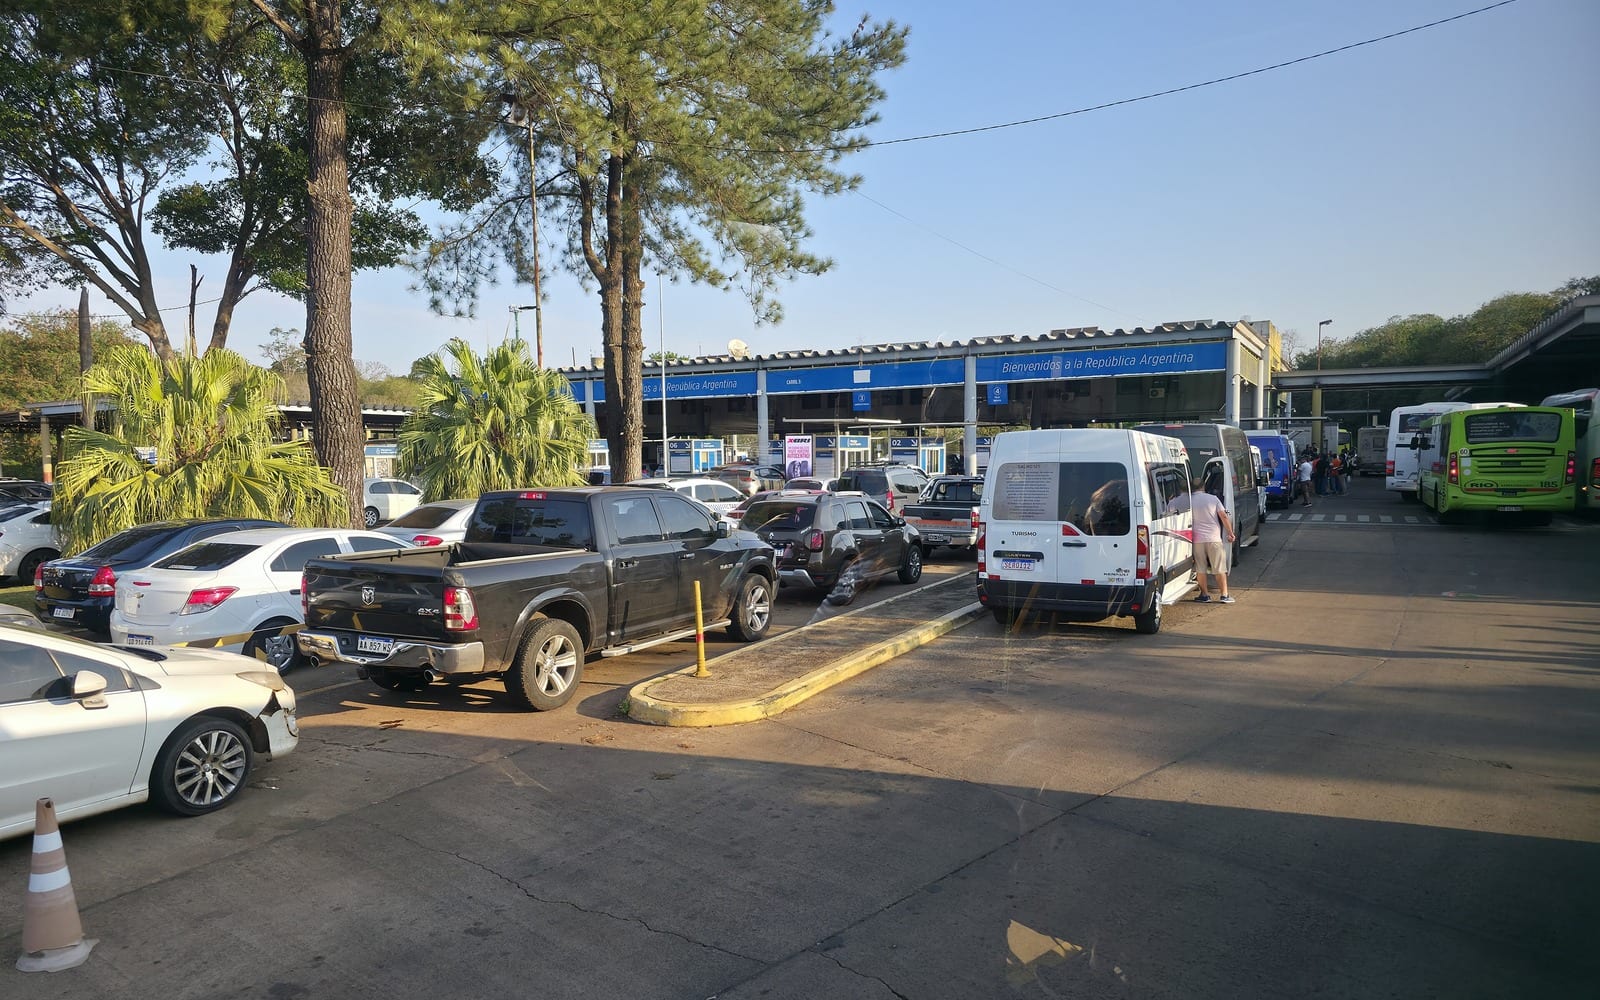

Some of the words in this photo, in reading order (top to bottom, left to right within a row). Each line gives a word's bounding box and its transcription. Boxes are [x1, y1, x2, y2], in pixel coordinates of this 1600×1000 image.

[1002, 359, 1061, 373] Bienvenidos
[1064, 361, 1071, 370] a
[1073, 358, 1083, 369] la
[1085, 355, 1136, 369] República
[1139, 351, 1194, 367] Argentina
[652, 384, 658, 392] a
[666, 380, 700, 393] República
[702, 379, 737, 391] Argentina
[359, 640, 367, 649] AA
